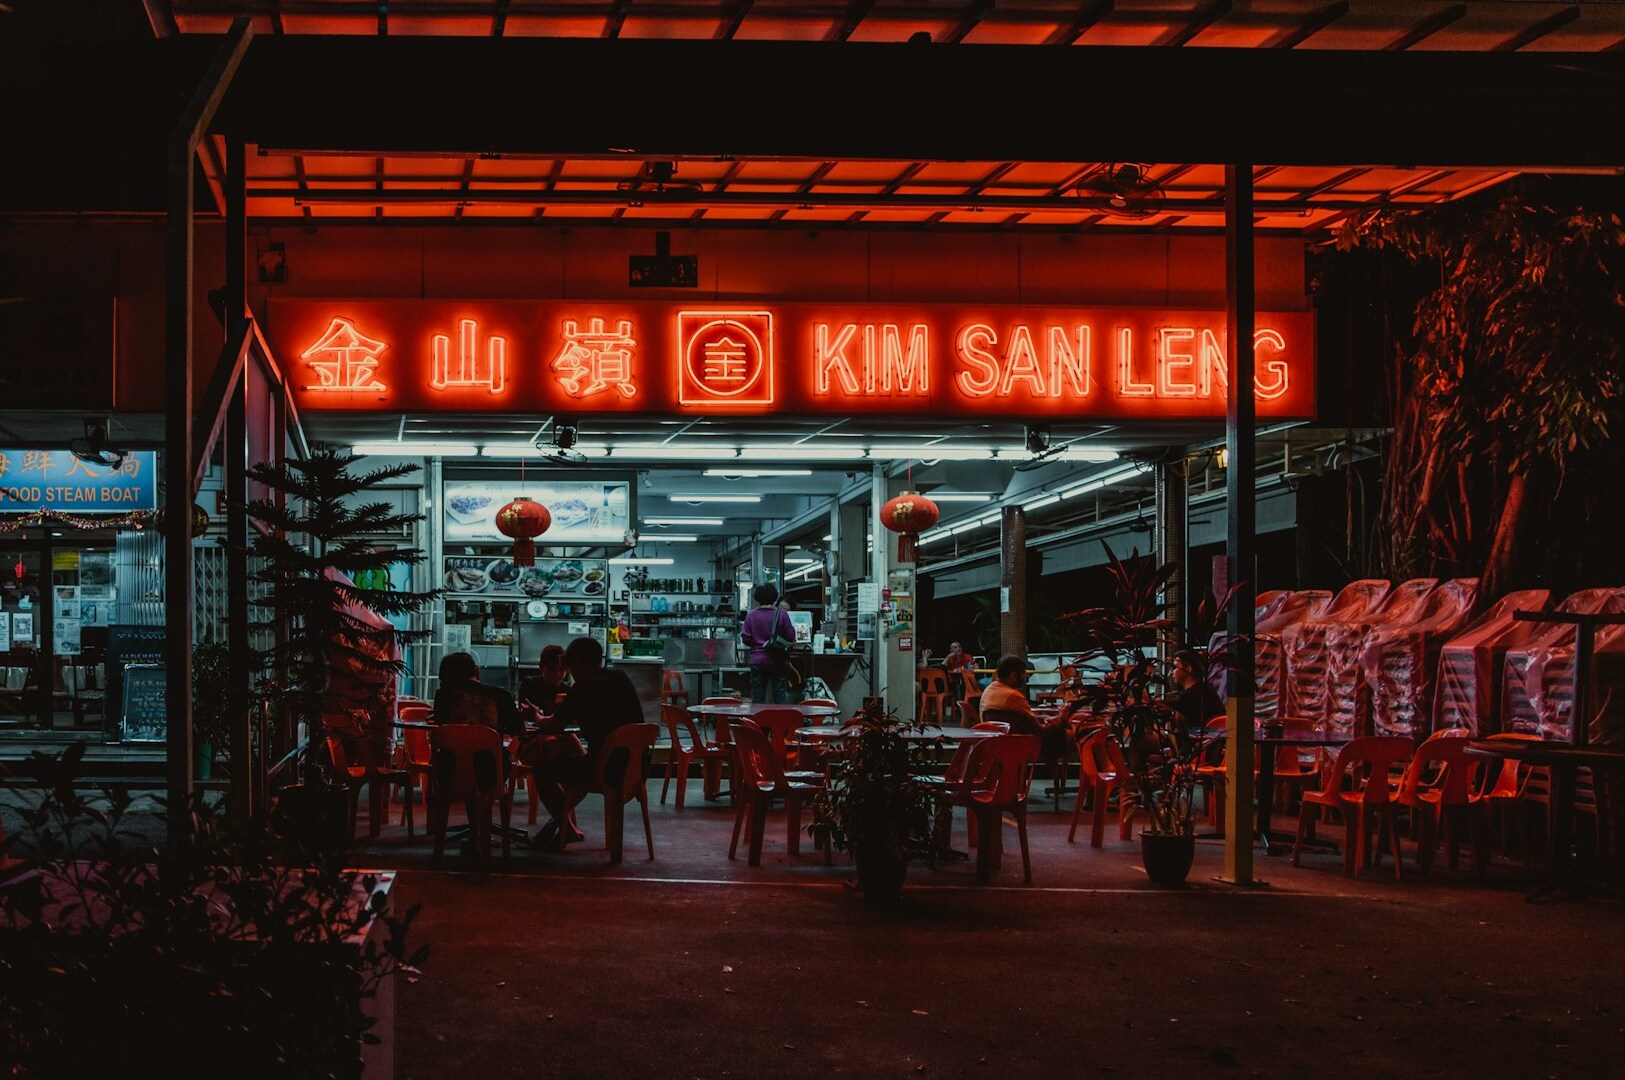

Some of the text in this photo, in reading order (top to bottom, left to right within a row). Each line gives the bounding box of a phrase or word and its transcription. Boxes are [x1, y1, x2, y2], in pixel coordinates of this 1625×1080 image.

[301, 317, 637, 397] 金山嶺
[814, 322, 1290, 399] KIM SAN LENG
[45, 486, 96, 502] STEAM
[100, 486, 141, 502] BOAT
